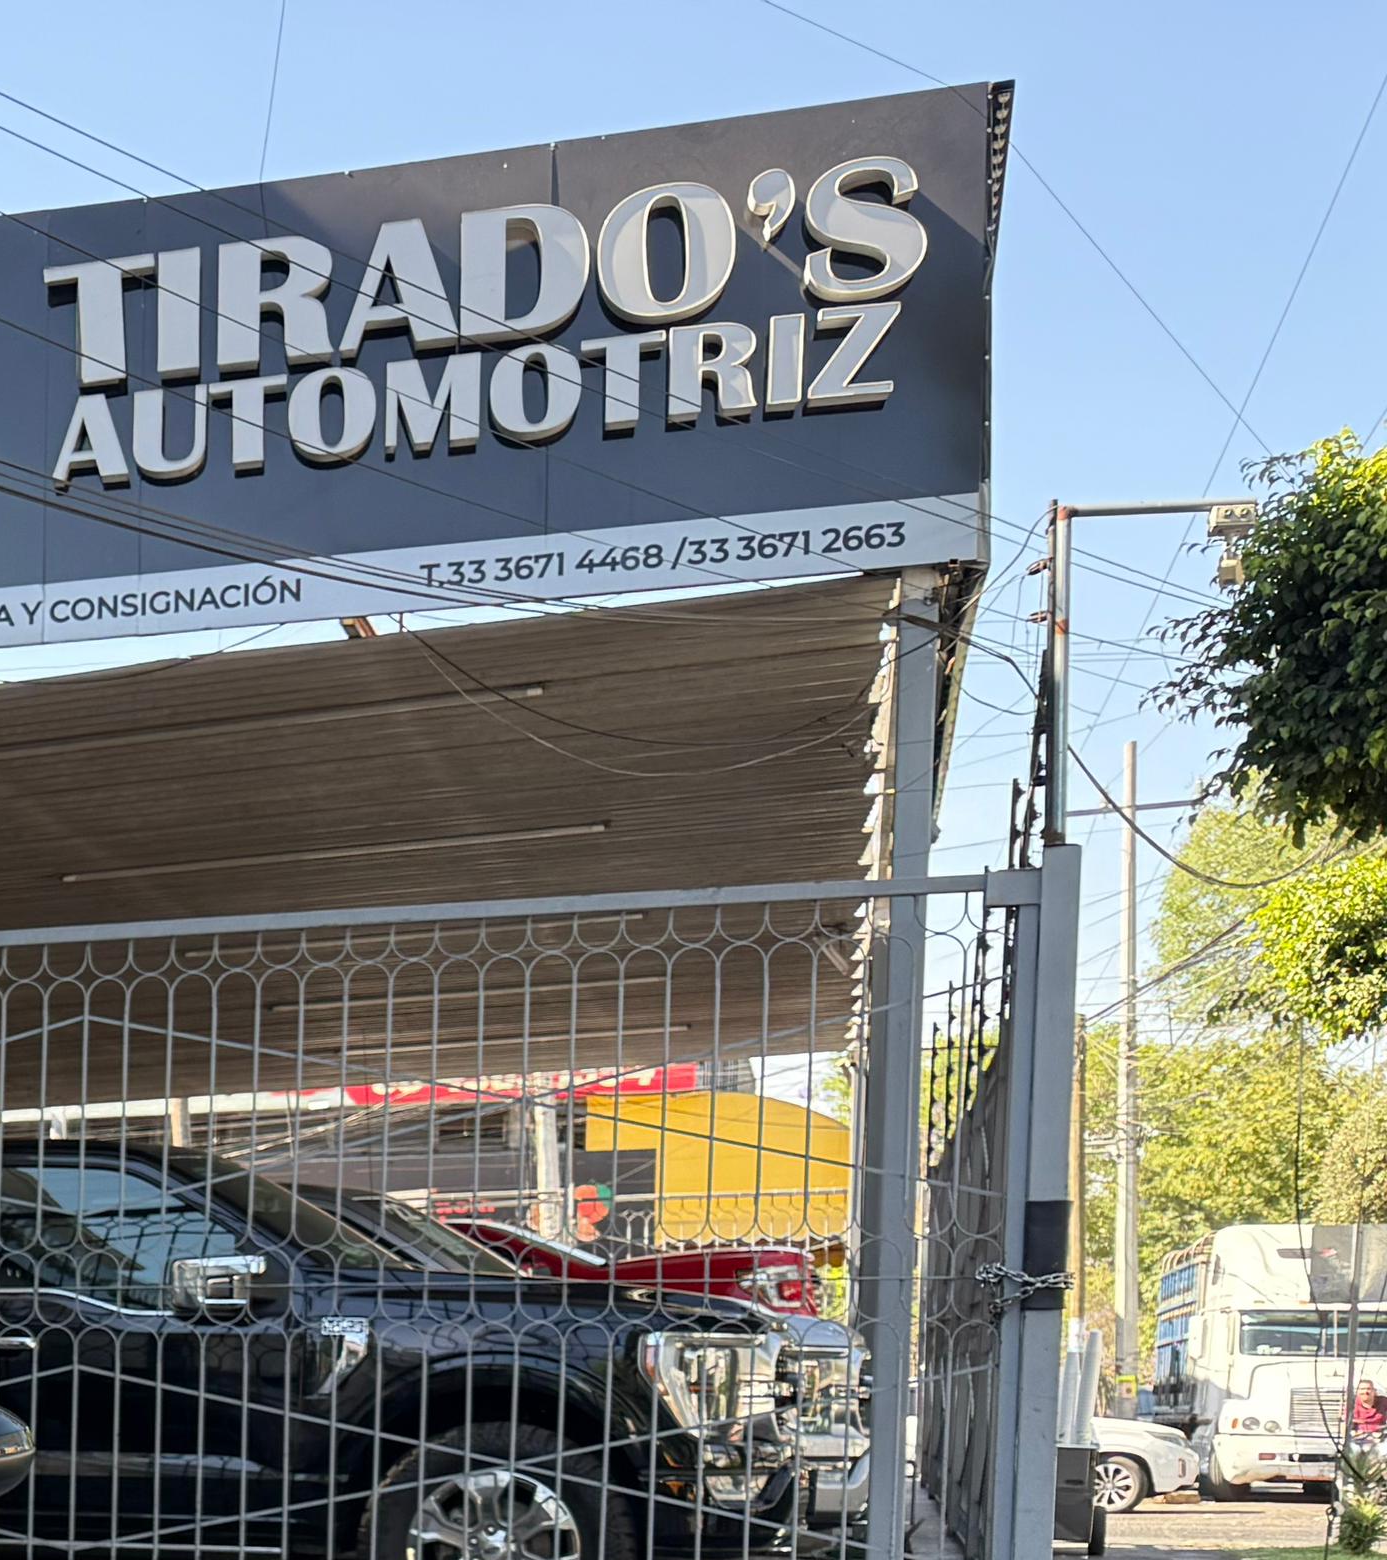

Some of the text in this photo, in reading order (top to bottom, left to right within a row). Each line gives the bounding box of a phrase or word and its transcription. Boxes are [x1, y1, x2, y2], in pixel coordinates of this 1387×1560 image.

[43, 155, 928, 387] TIRADO'S
[52, 301, 902, 489] AUTOMOTRIZ
[20, 601, 44, 626] Y
[48, 577, 302, 624] CONSIGNACIÓN
[494, 552, 564, 581] 3671
[575, 543, 664, 574] 4468
[735, 529, 811, 559] 3671
[820, 520, 906, 553] 2663
